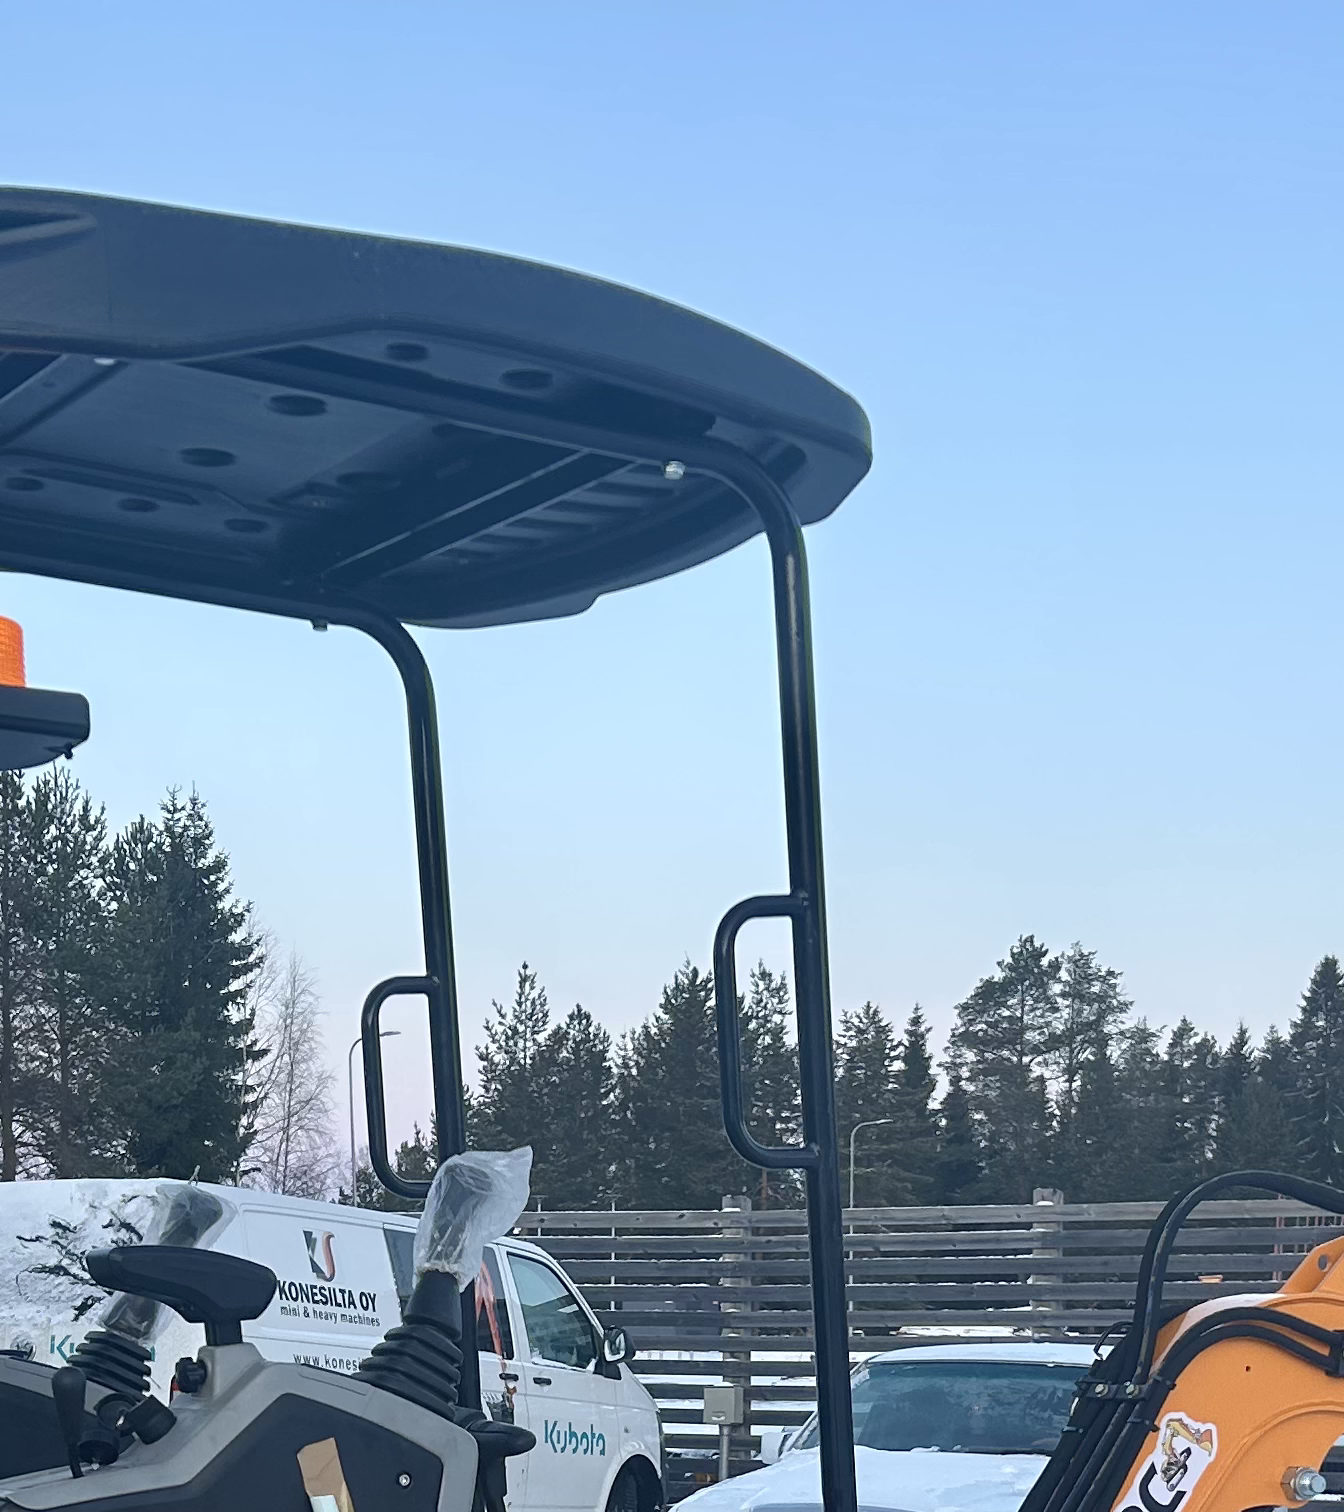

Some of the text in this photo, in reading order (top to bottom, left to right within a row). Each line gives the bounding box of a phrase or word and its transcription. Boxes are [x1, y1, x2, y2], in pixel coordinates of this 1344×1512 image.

[277, 1279, 377, 1313] KONESILTA OY
[280, 1303, 381, 1327] mini & heavy machines
[544, 1419, 606, 1457] Kubota
